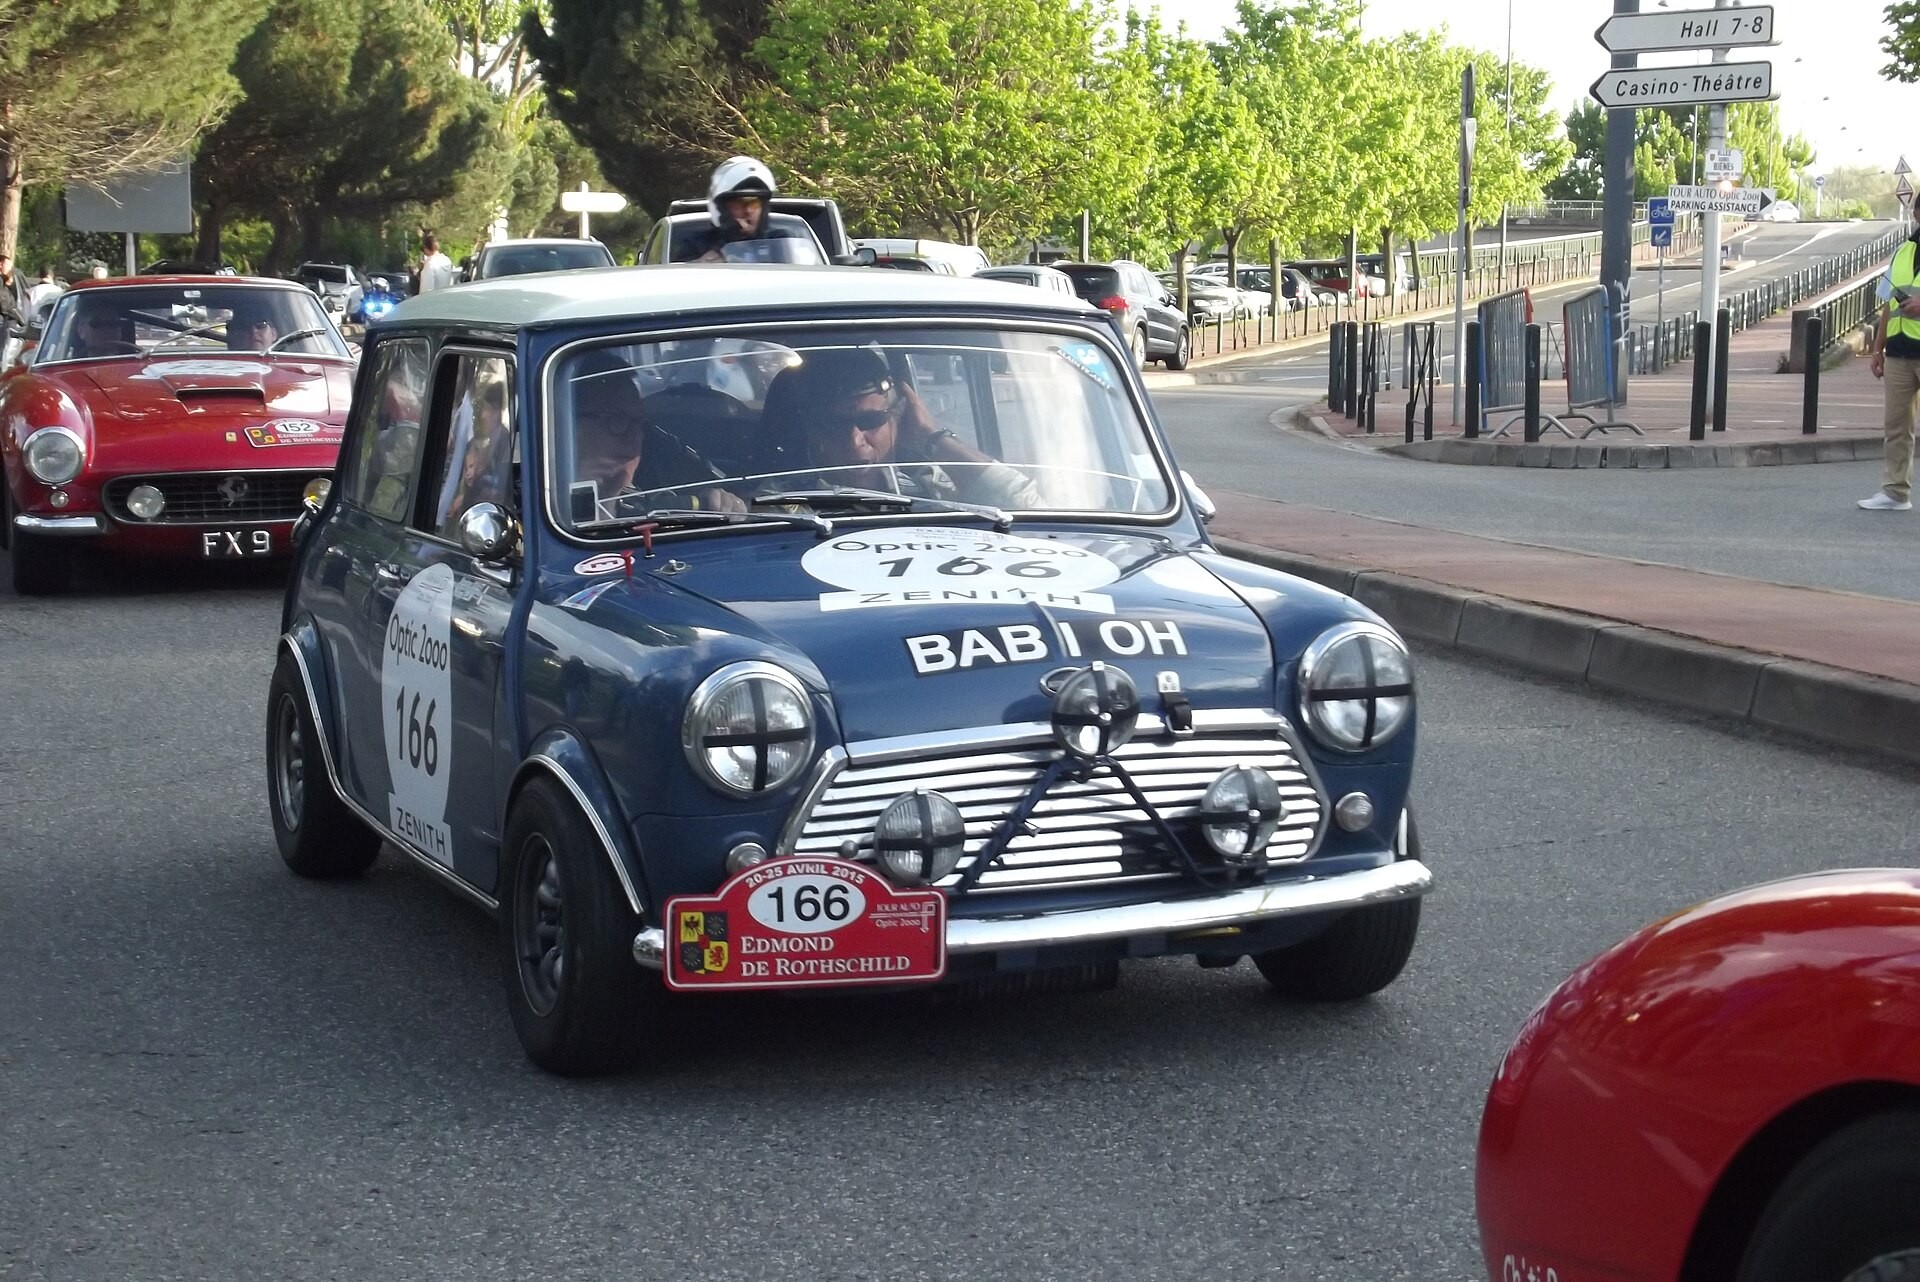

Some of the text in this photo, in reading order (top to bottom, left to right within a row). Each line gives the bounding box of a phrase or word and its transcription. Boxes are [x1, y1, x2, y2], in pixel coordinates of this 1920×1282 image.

[1681, 16, 1763, 38] Hall 7-8
[1670, 187, 1691, 198] TOUR
[1694, 188, 1717, 199] AUTO
[1671, 200, 1757, 213] PARKING ASSISTANCE
[280, 423, 314, 432] 152
[832, 540, 957, 553] Optic
[879, 555, 1061, 579] 166
[860, 587, 1081, 605] ZENITH
[390, 613, 418, 666] Optic
[396, 685, 438, 777] 166
[397, 806, 447, 856] ZENITH
[746, 863, 865, 888] 20-25 AVRIL 2015
[767, 884, 850, 923] 166
[740, 936, 834, 954] EDMOND
[741, 956, 911, 976] DE ROTHSCHILD
